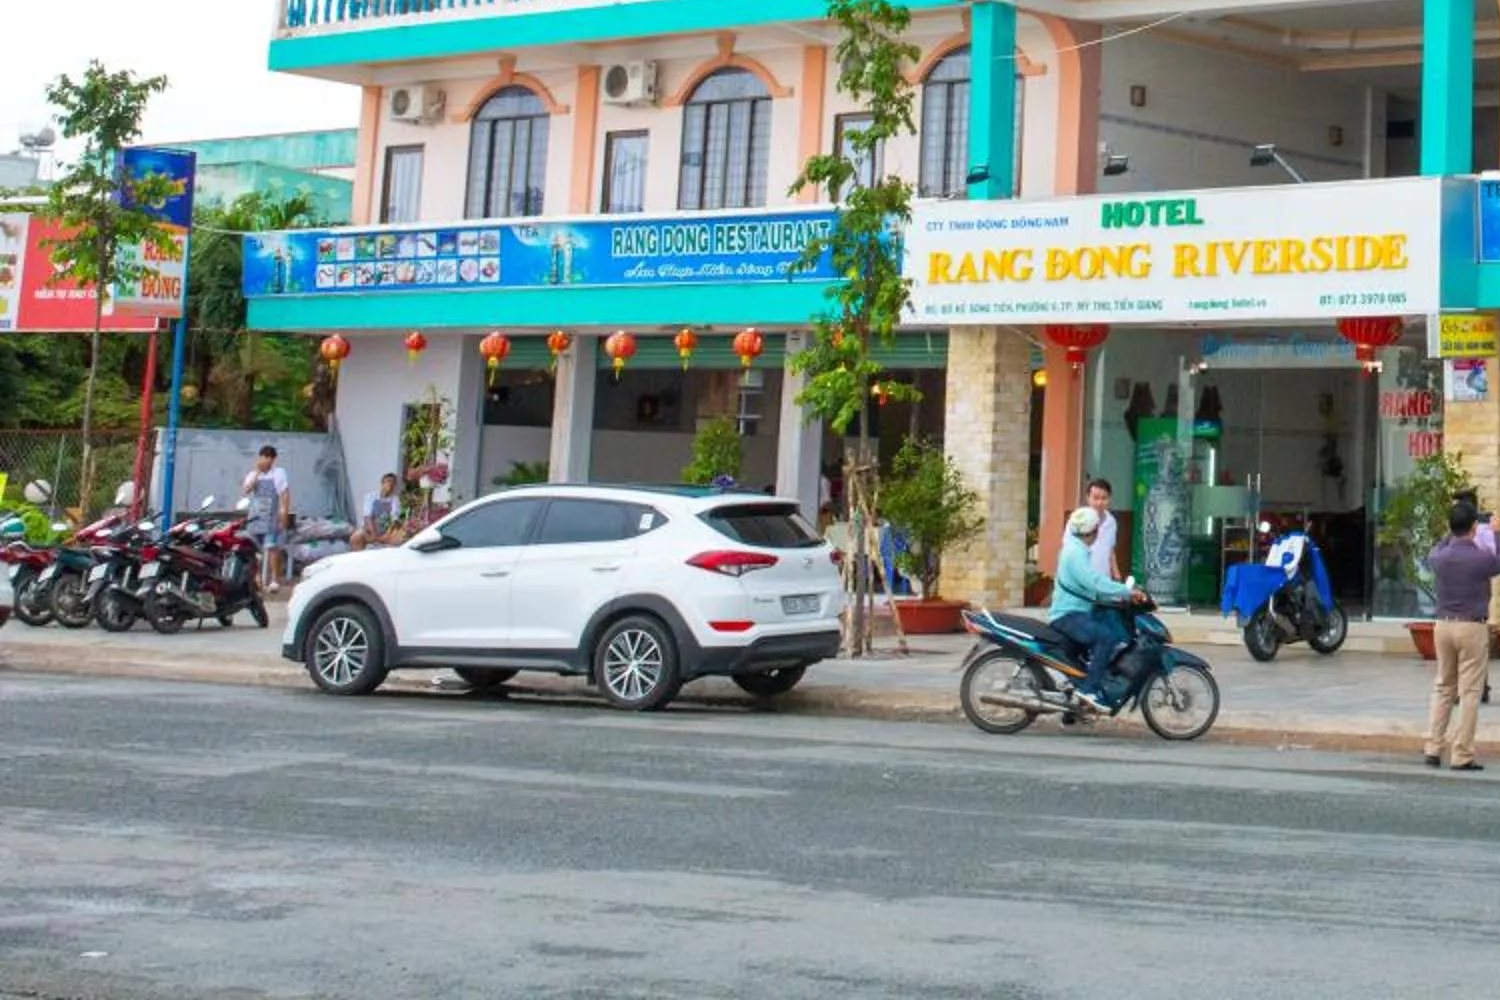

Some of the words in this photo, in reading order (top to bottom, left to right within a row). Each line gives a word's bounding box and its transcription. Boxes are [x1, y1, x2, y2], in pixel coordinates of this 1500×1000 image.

[1102, 198, 1204, 230] HOTEL
[612, 228, 657, 258] RANG
[661, 225, 710, 256] DONG
[714, 219, 832, 254] RESTAURANT
[927, 246, 1034, 285] RANG
[1172, 233, 1409, 278] RIVERSIDE
